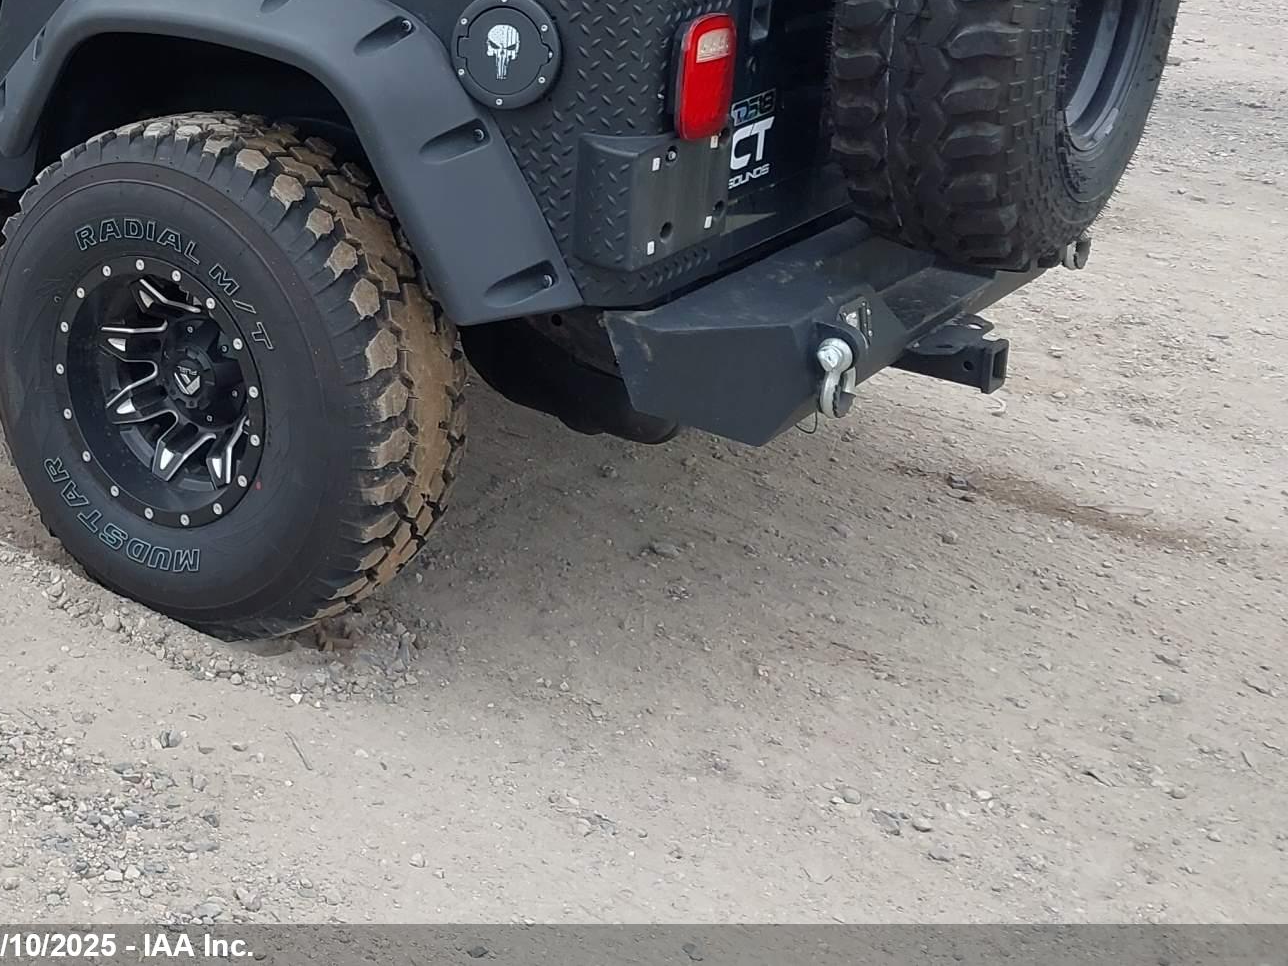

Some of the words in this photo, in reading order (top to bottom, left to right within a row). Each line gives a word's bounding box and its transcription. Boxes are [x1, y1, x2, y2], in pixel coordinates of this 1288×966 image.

[730, 115, 776, 171] CT
[73, 217, 201, 266] RADIAL
[208, 264, 275, 351] M/T
[43, 456, 201, 573] MUDSTAR
